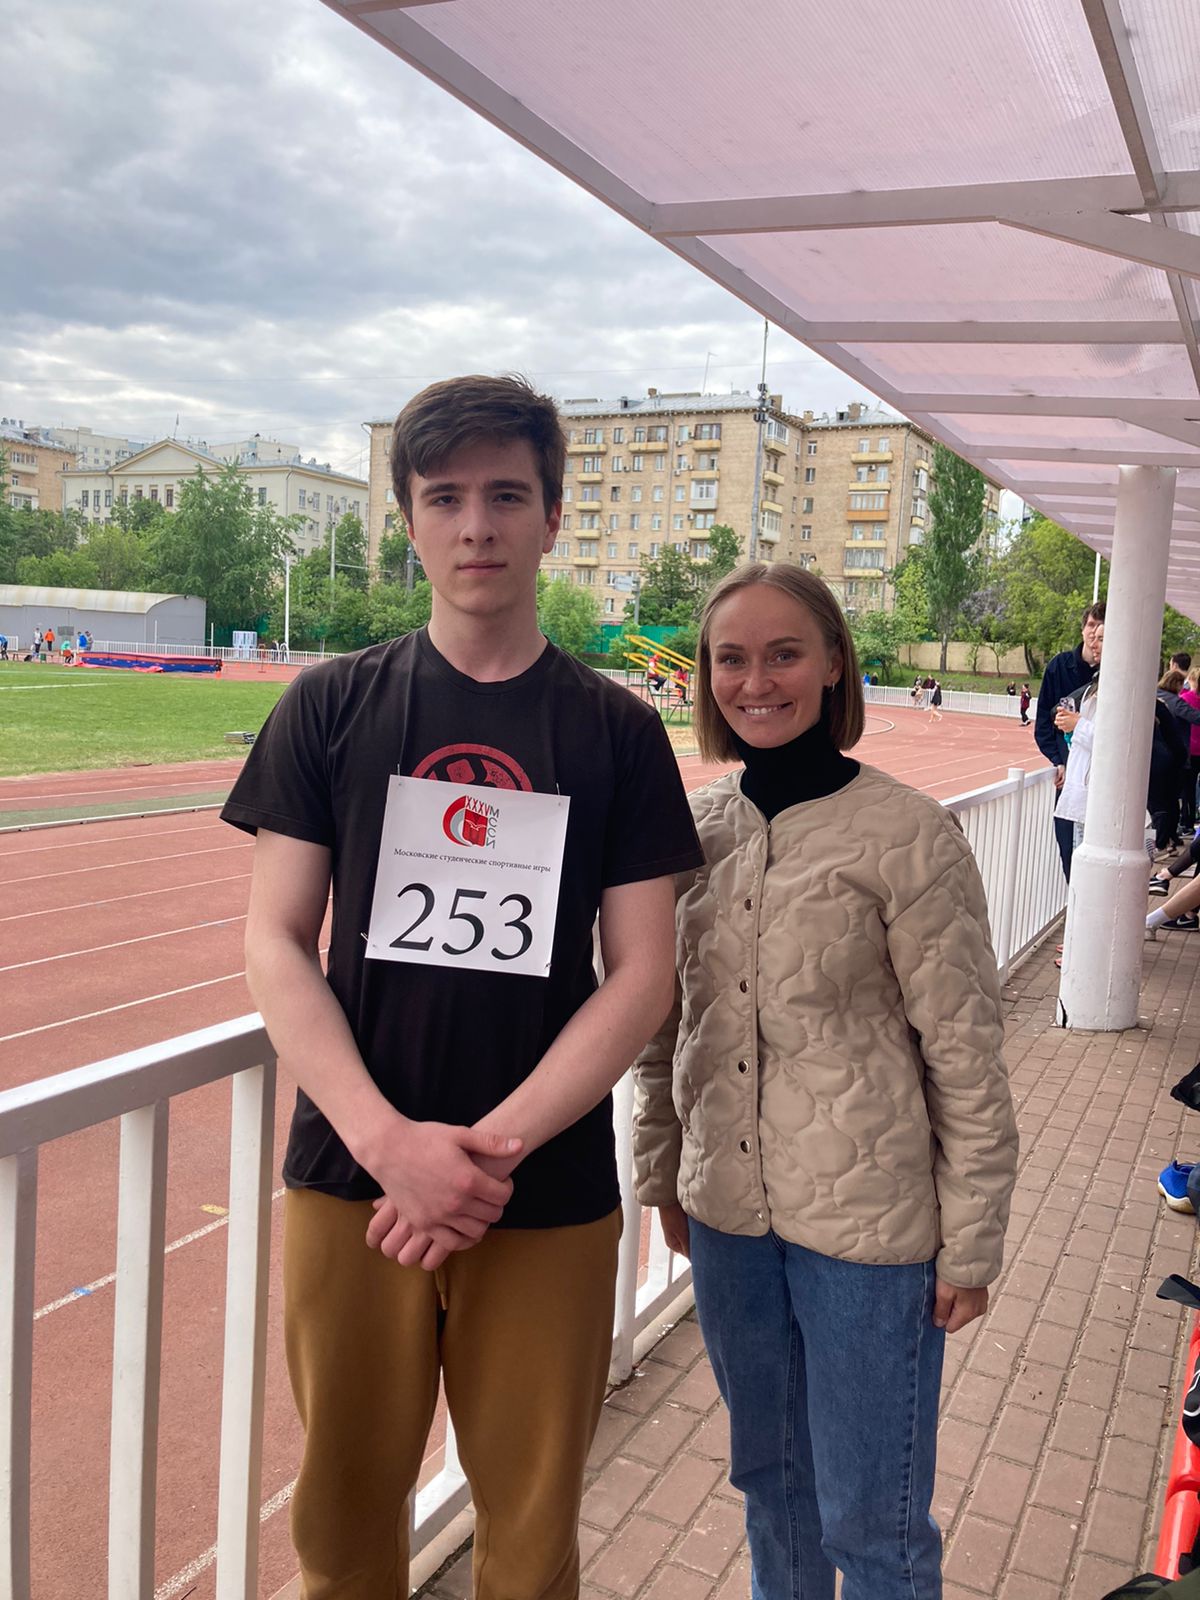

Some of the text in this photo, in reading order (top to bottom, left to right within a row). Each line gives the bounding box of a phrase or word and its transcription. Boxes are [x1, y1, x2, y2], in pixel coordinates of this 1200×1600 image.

[486, 805, 500, 850] МССИ
[394, 848, 551, 873] Московские студенческие спортивные игры
[389, 882, 534, 961] 253
